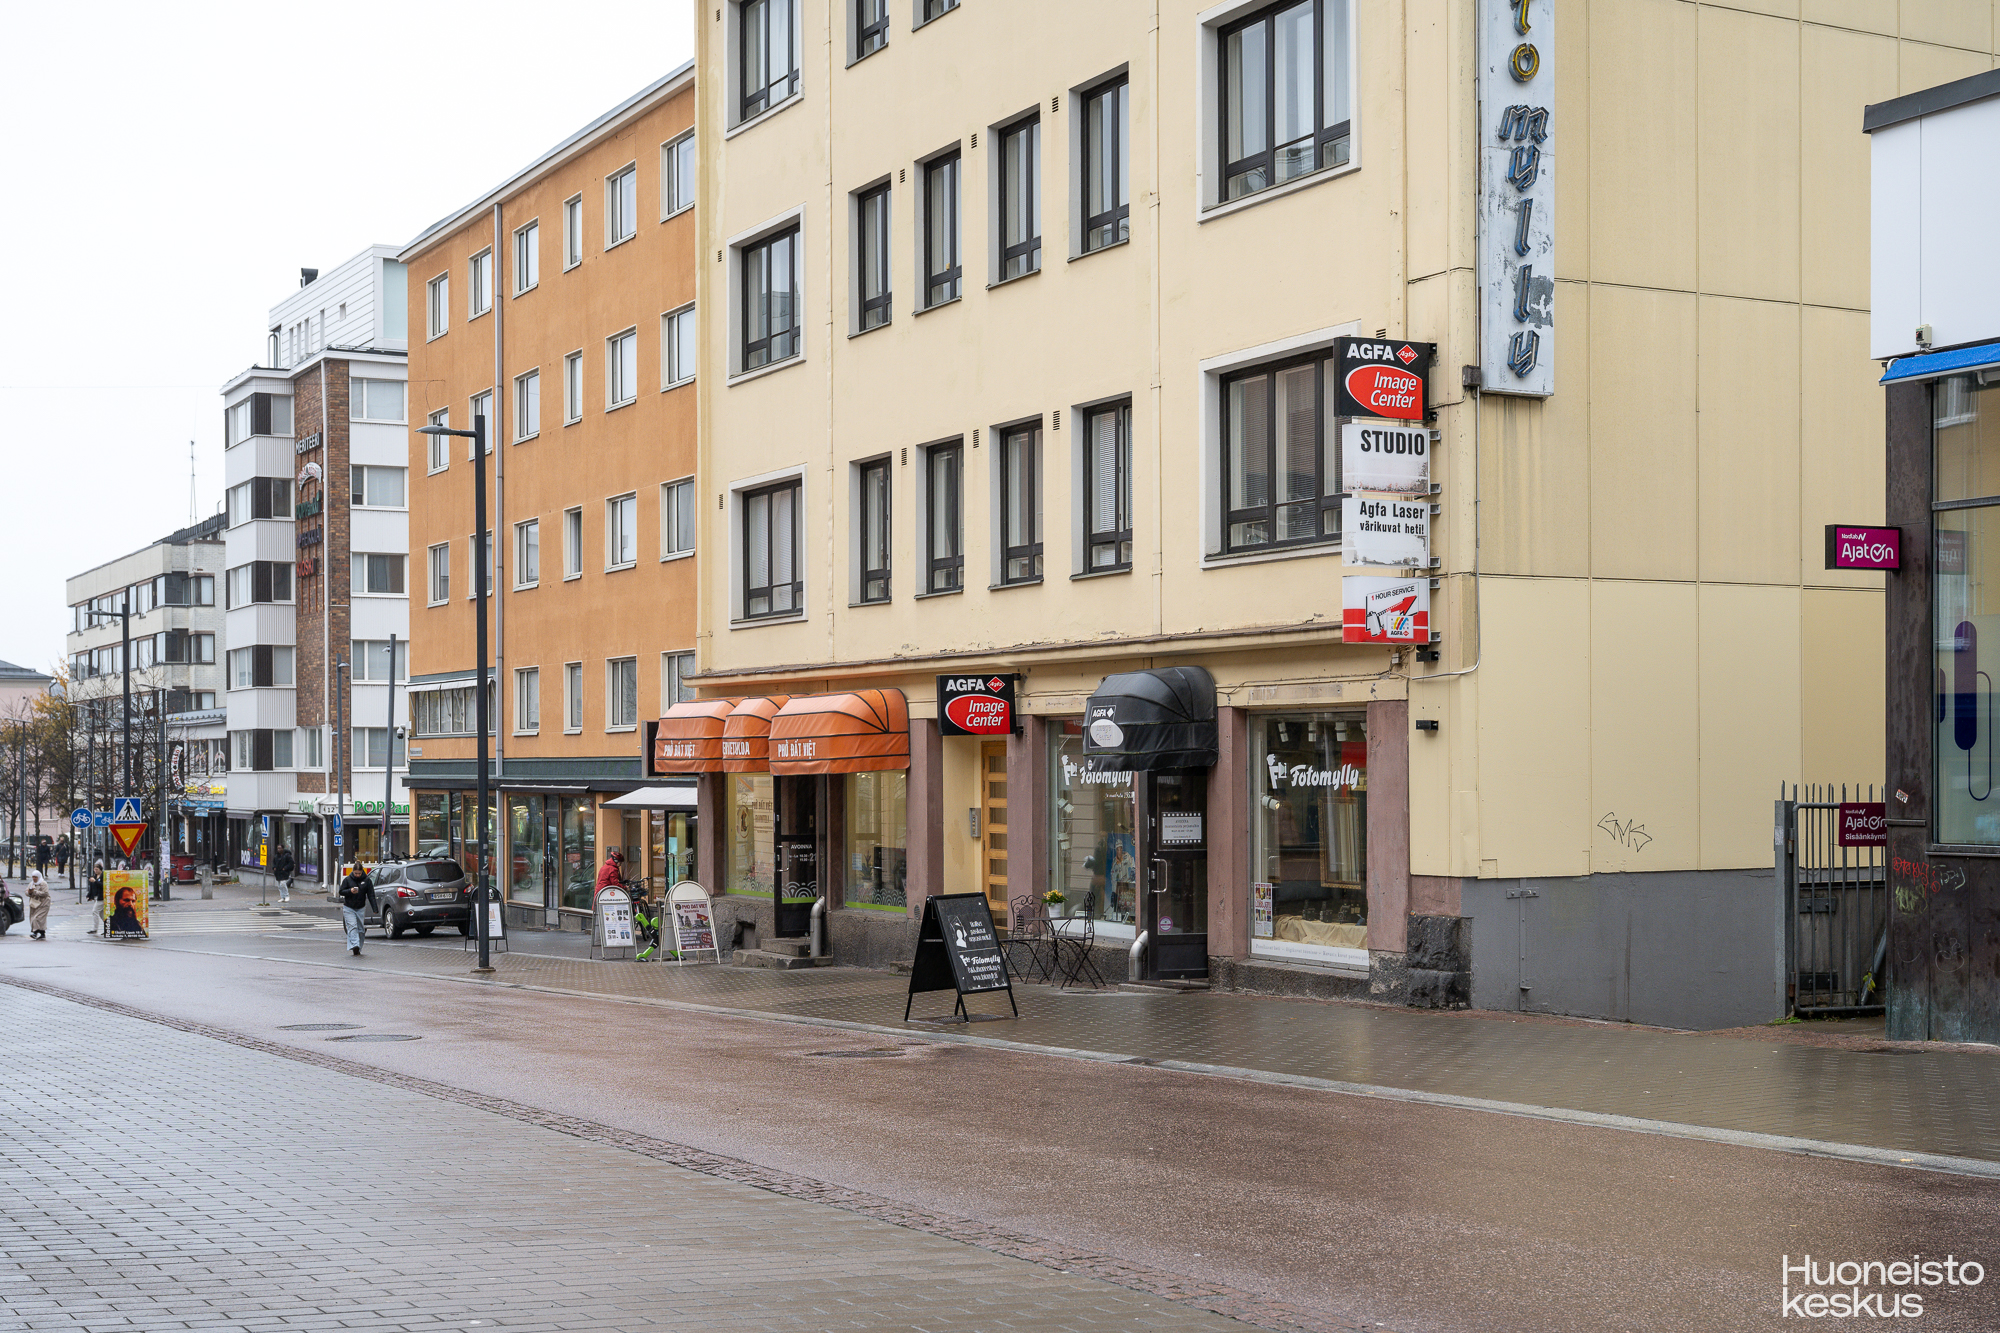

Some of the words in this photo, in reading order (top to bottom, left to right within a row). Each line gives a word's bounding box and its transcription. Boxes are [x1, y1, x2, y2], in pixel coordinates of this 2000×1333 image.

[1347, 343, 1395, 361] AGFA
[1374, 372, 1417, 394] Image
[1370, 390, 1415, 408] Center
[1361, 429, 1425, 456] STUDIO
[1360, 501, 1387, 518] Agfa
[1393, 503, 1425, 519] Laser
[1360, 521, 1401, 533] värikuvat
[1405, 523, 1424, 534] heti!
[1375, 591, 1392, 600] HOUR
[1392, 585, 1415, 597] SERVICE
[946, 679, 986, 691] AGFA
[968, 700, 1005, 716] Image
[1092, 708, 1107, 717] AGFA
[966, 714, 1004, 727] Center
[1289, 763, 1359, 791] Fotomylly
[1845, 833, 1887, 841] Sisäänkäynti
